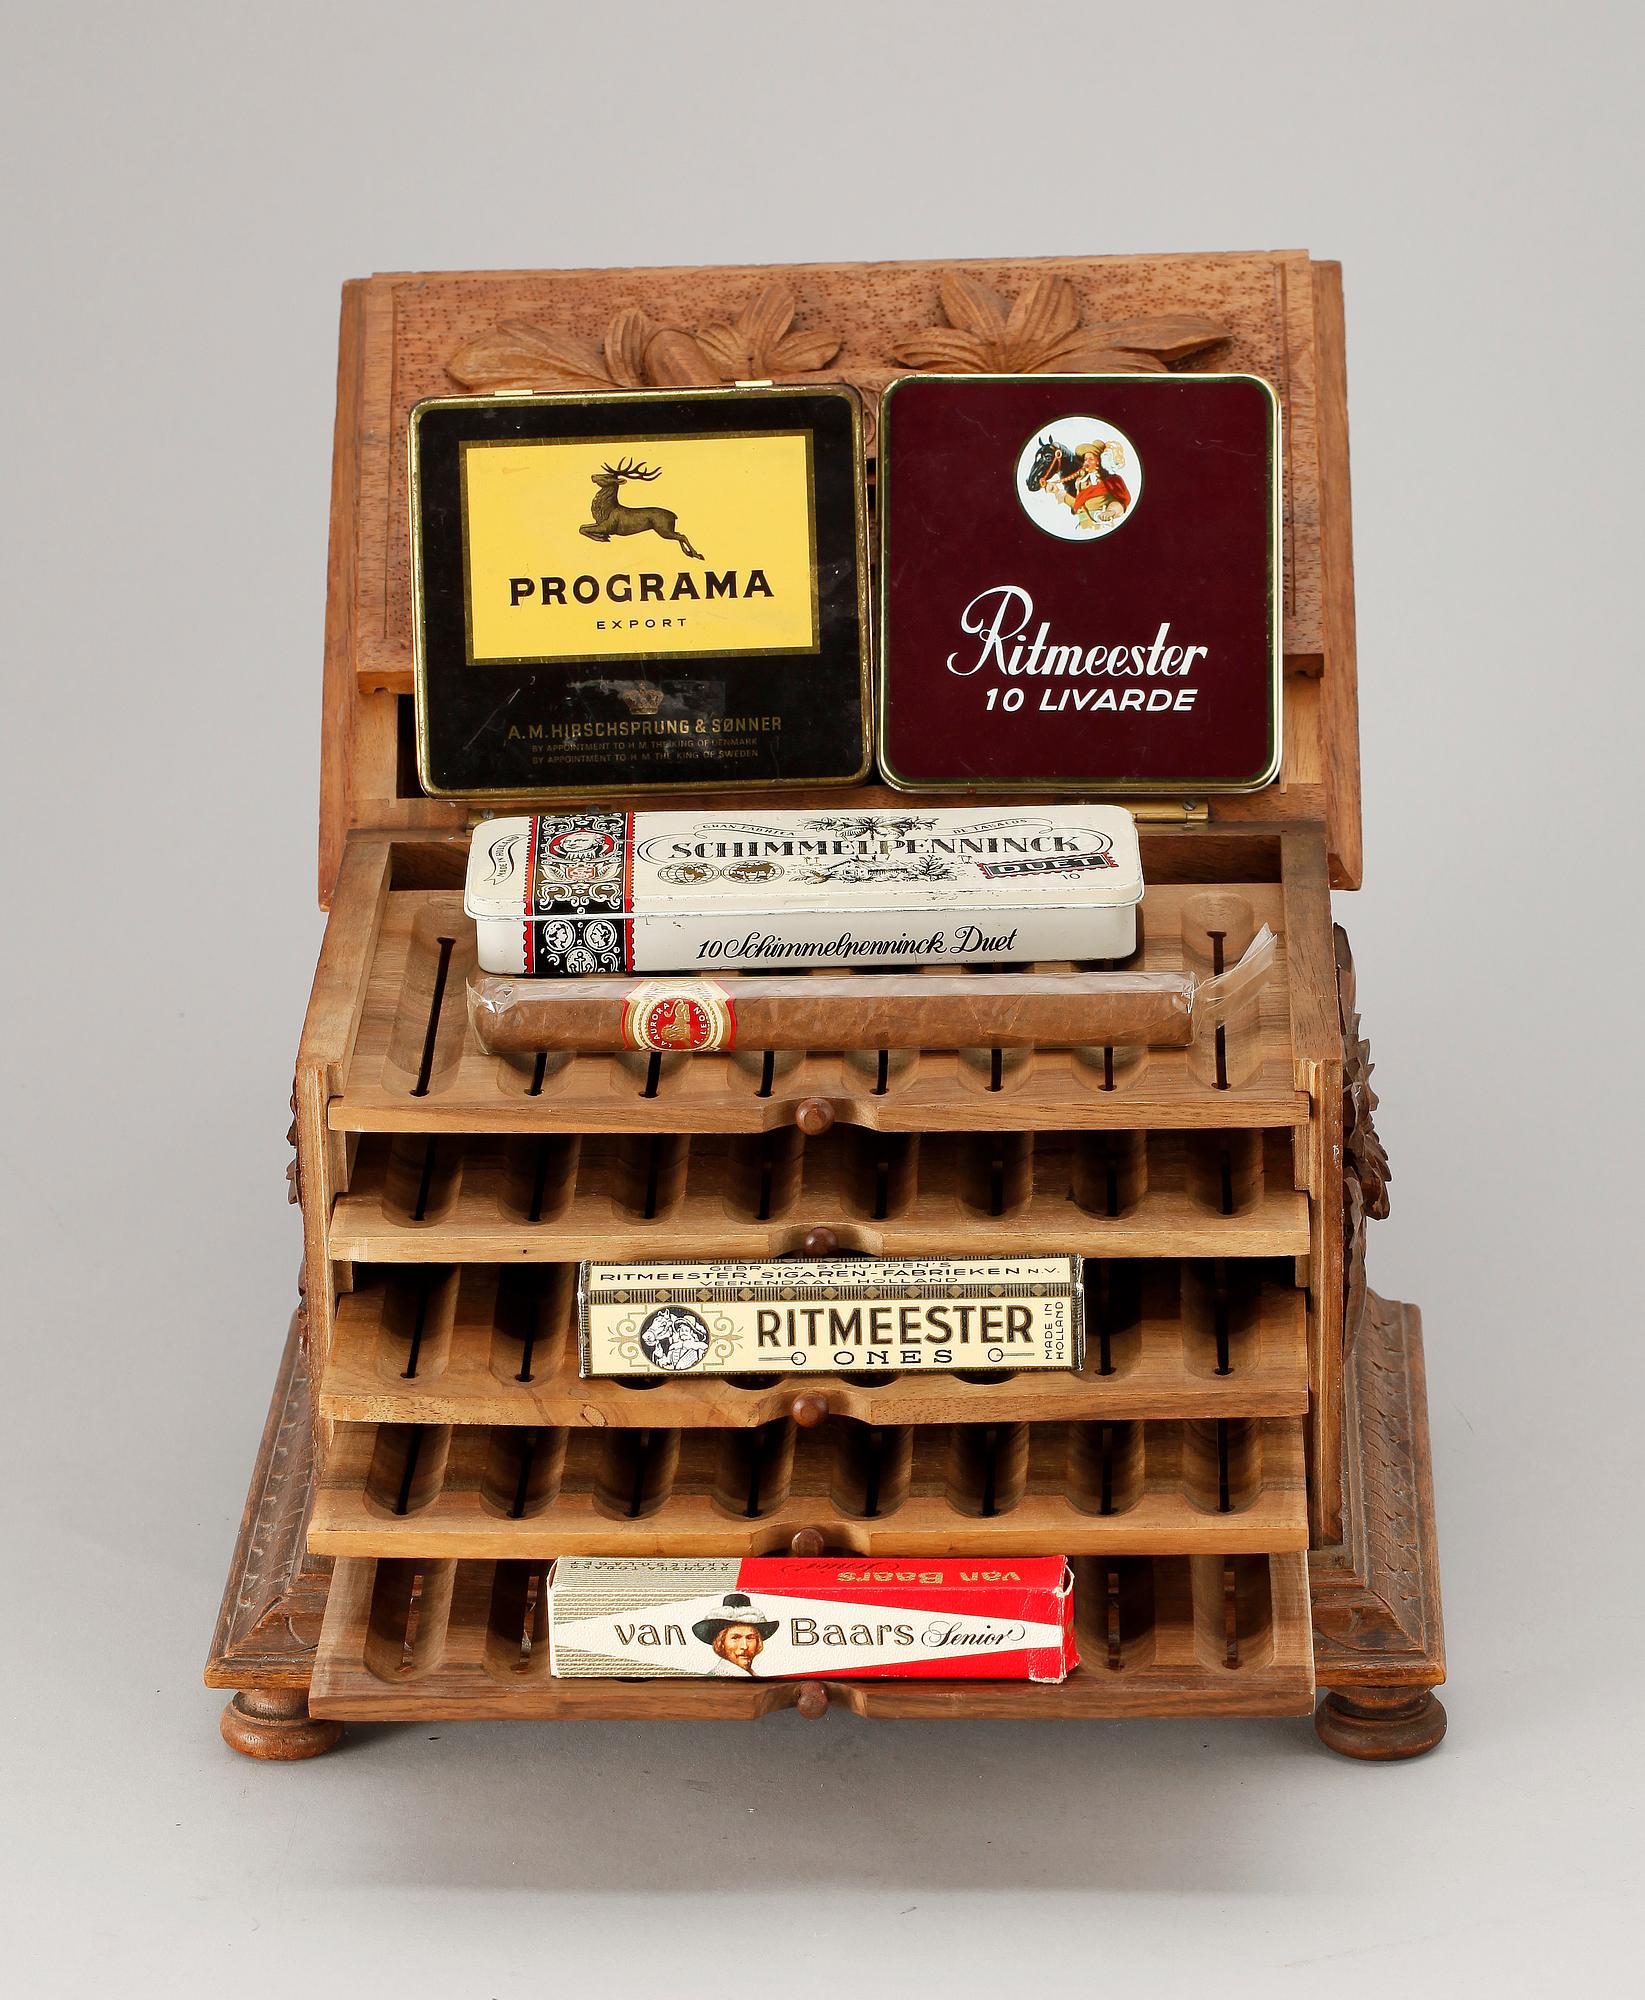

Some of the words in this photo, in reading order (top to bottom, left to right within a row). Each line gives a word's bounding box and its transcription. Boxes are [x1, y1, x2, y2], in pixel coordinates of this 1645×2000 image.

[509, 569, 774, 607] PROGRAMA
[597, 618, 687, 630] EXPORT
[946, 585, 1208, 677] Ritmeester
[986, 687, 1024, 712] 10
[1039, 687, 1199, 712] LIVARDE
[695, 718, 706, 733] &
[712, 716, 782, 733] SØNNER
[532, 744, 543, 753] BY
[546, 742, 611, 752] APPOINTMENT
[614, 741, 625, 750] TO
[697, 738, 709, 748] OF
[532, 756, 544, 765] BY
[547, 754, 611, 764] APPOINTMENT
[614, 753, 626, 762] TO
[655, 751, 671, 761] THE
[677, 751, 699, 760] KING
[703, 750, 715, 759] OF
[719, 748, 759, 759] SWEDEN
[671, 837, 1081, 859] SCHIMMELPENNINCK
[996, 856, 1094, 874] DUET
[1062, 873, 1081, 881] 10
[950, 926, 1018, 954] Duet
[650, 1002, 671, 1041] AURORA
[600, 1271, 747, 1281] RITMEESTER
[1027, 1267, 1060, 1275] N.V.
[816, 1261, 952, 1271] SCHUPPEN'S
[699, 1279, 838, 1287] VEENENDAAL
[857, 1277, 958, 1285] HOLLAND
[1044, 1303, 1053, 1316] IN
[757, 1305, 1034, 1346] RITMEESTER
[1054, 1301, 1064, 1360] HOLLAND
[1044, 1322, 1053, 1360] MADE
[833, 1349, 954, 1366] ONES
[837, 1571, 944, 1584] Baars
[960, 1571, 1021, 1582] van
[614, 1623, 687, 1647] van
[790, 1617, 914, 1646] Baars
[920, 1619, 1026, 1649] Senior
